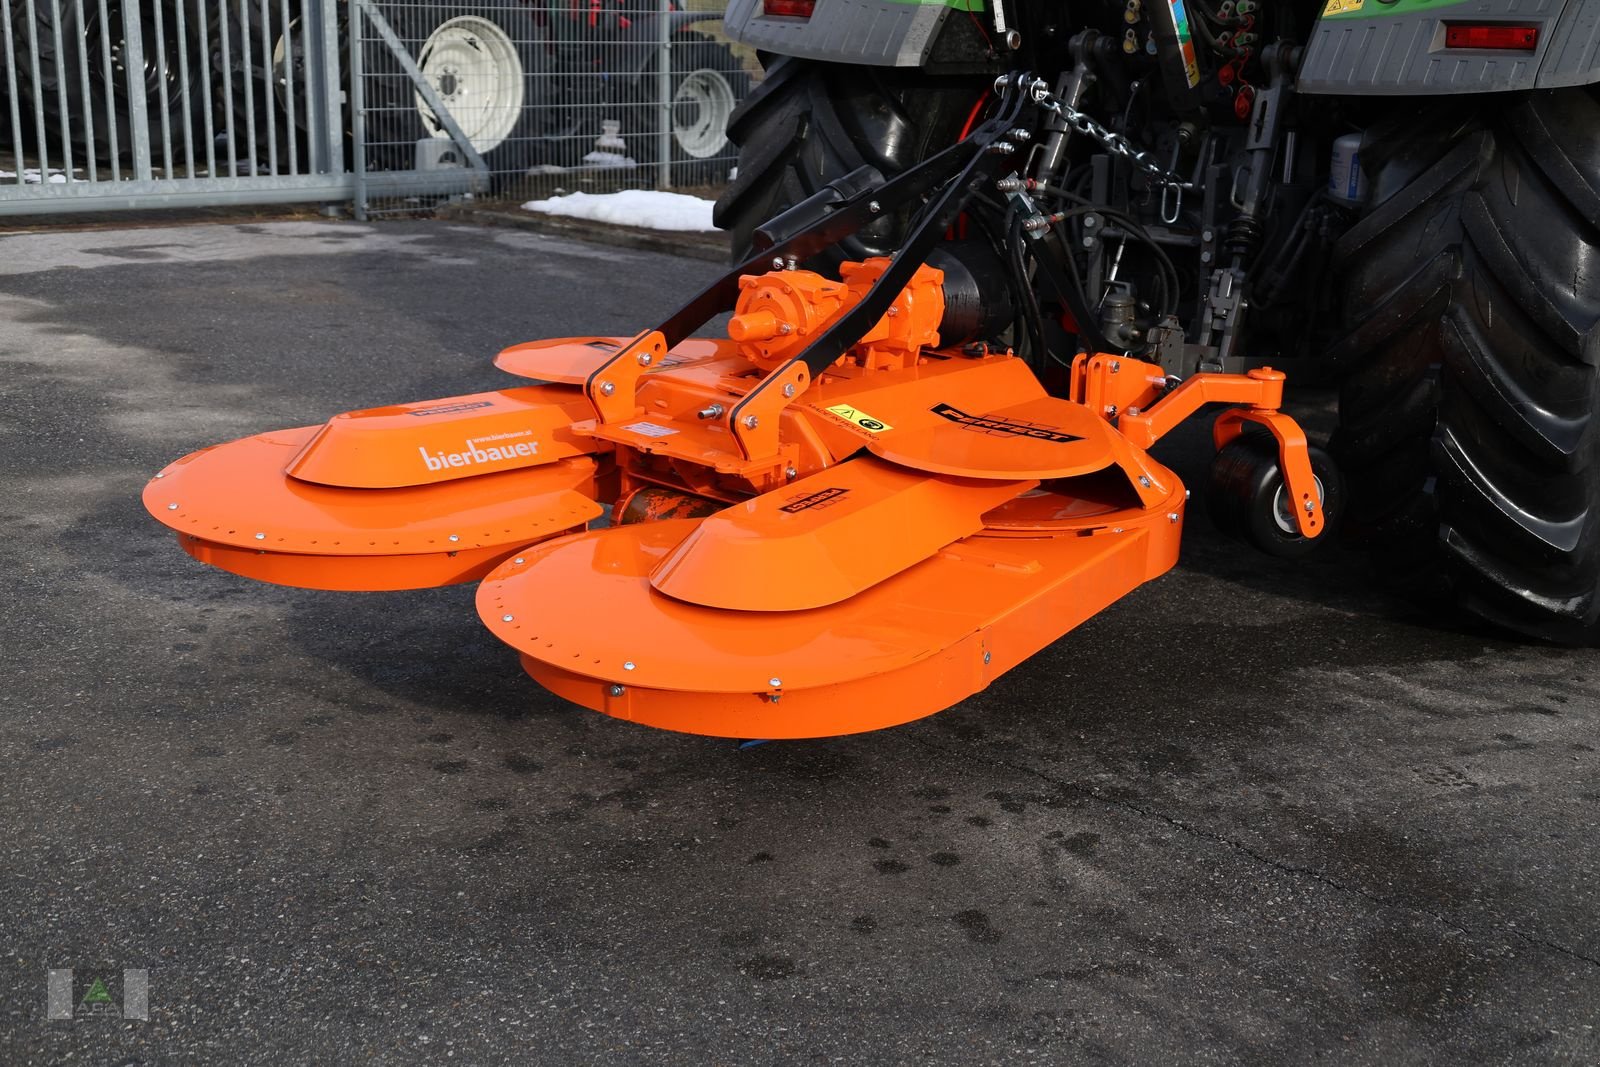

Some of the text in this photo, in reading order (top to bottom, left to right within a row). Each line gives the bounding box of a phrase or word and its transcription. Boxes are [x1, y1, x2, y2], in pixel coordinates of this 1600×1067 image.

[808, 403, 830, 416] MADE
[840, 419, 880, 441] HOLLAND
[940, 409, 1070, 440] PERFECT
[419, 440, 538, 471] bierbauer
[785, 488, 844, 512] PERFECT
